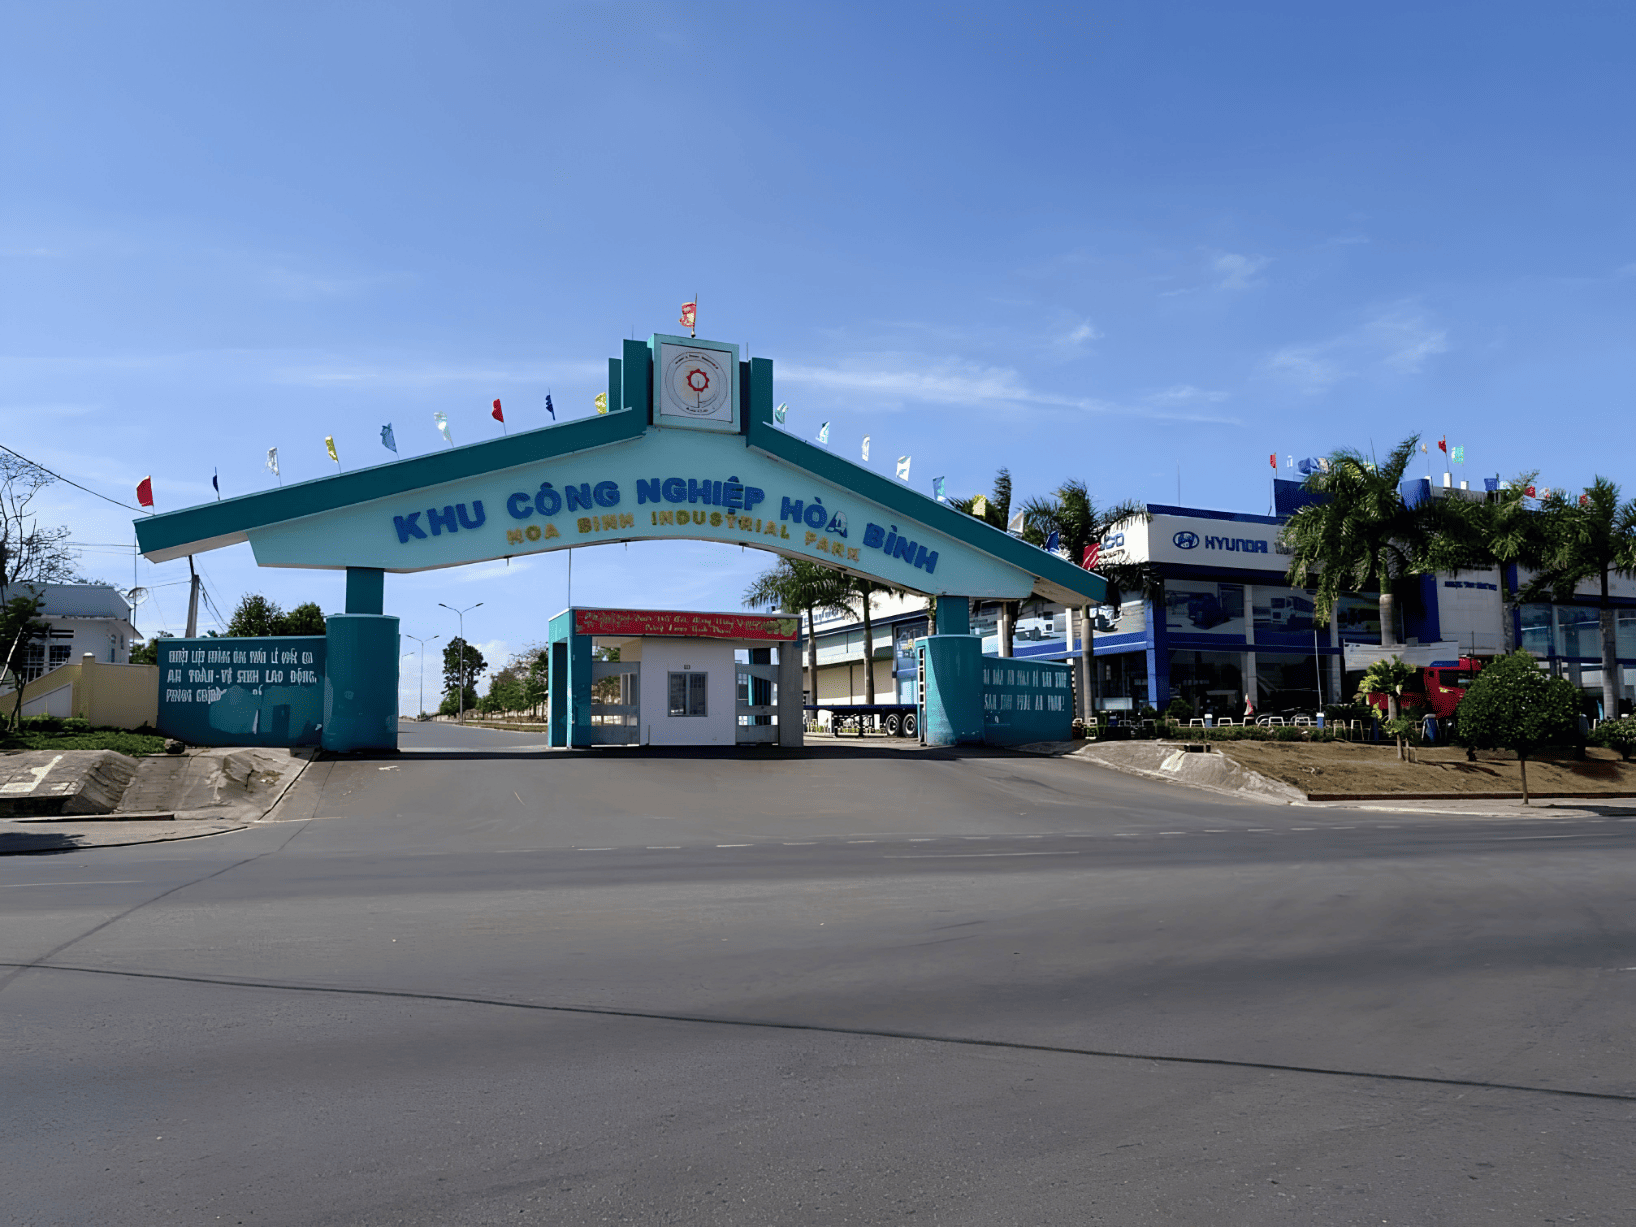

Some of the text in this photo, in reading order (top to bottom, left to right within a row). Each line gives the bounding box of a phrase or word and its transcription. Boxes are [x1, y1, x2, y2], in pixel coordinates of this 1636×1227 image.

[393, 475, 939, 574] KHU CÔNG NGHIỆP HÒA BÌNH
[506, 509, 861, 563] HOA BINH INDUSTRIAL PARK
[265, 670, 284, 683] LAO
